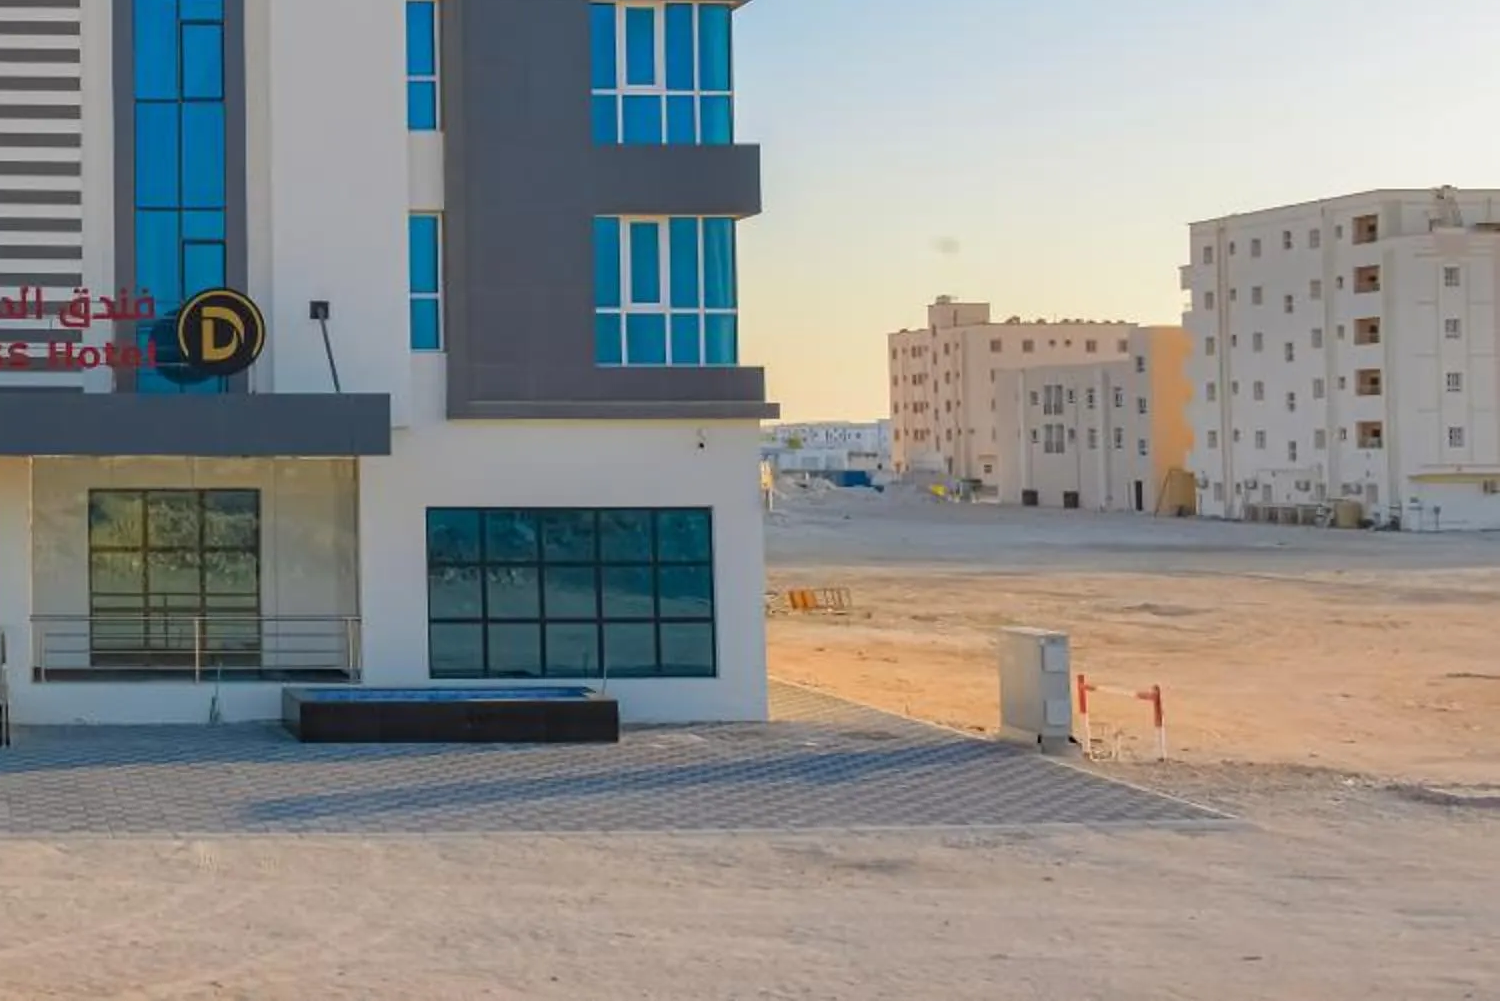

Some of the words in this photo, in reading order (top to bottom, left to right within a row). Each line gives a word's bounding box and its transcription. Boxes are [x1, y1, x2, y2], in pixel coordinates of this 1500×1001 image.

[59, 288, 155, 328] فندق
[202, 305, 246, 362] D
[48, 340, 157, 369] Hotel
